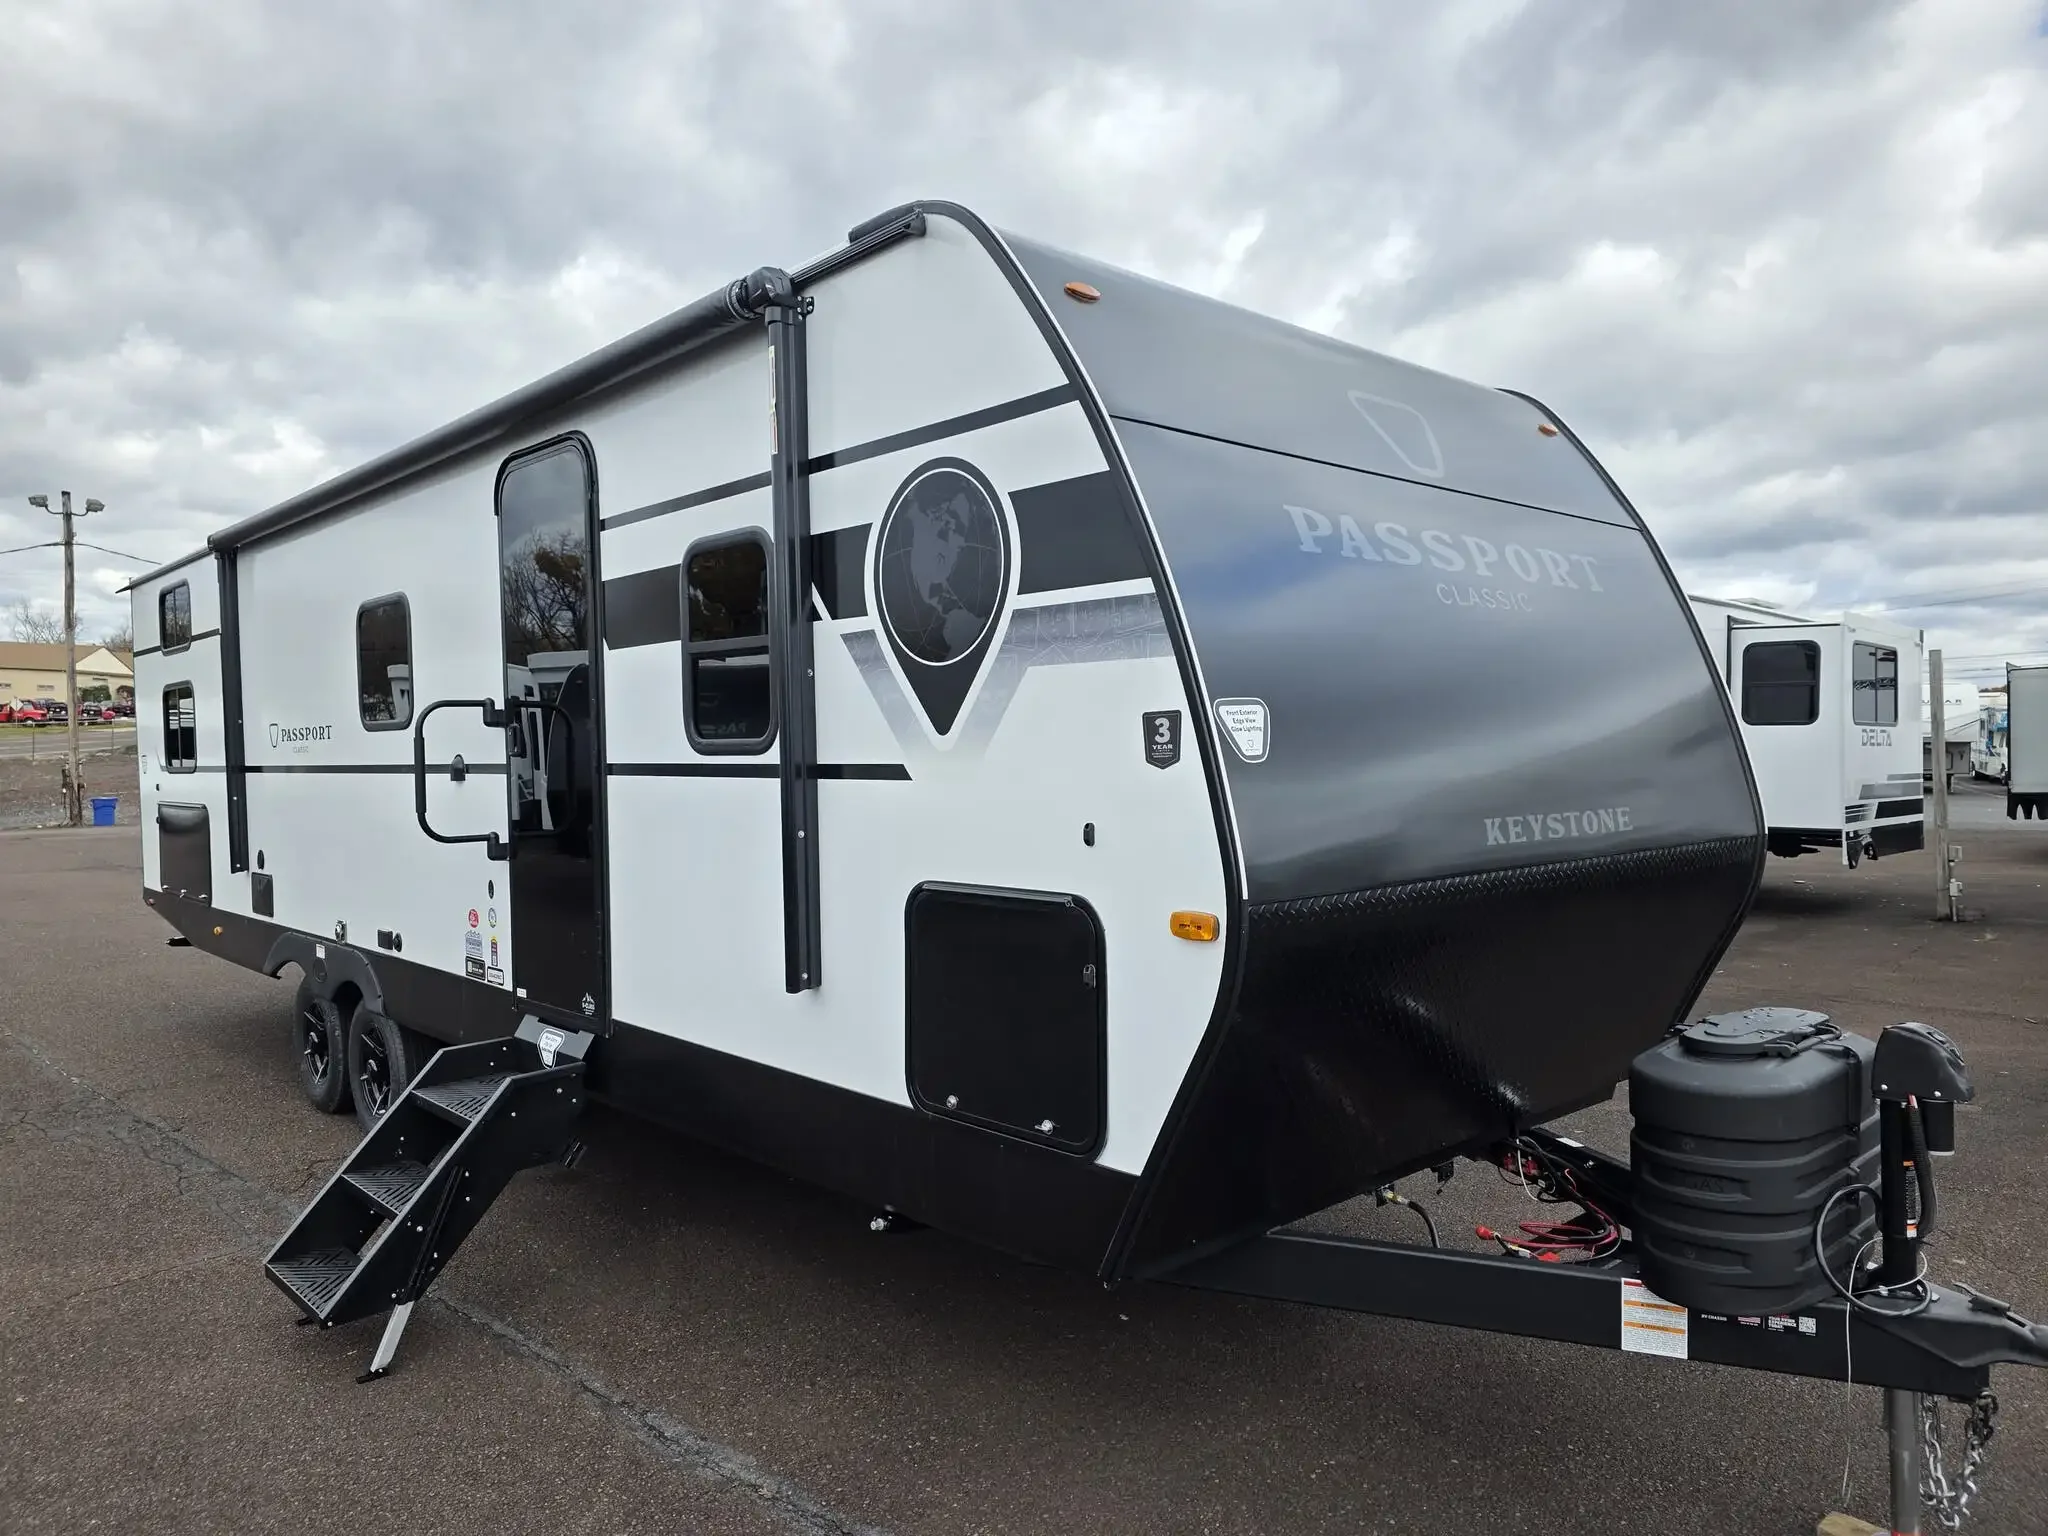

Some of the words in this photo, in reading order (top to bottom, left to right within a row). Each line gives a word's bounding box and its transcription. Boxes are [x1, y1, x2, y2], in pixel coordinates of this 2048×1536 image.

[1282, 504, 1604, 592] PASSPORT
[1436, 582, 1533, 613] CLASSIC
[281, 725, 333, 742] PASSPORT
[1154, 717, 1170, 744] 3
[1861, 729, 1892, 746] DELTA
[1484, 807, 1634, 846] KEYSTONE
